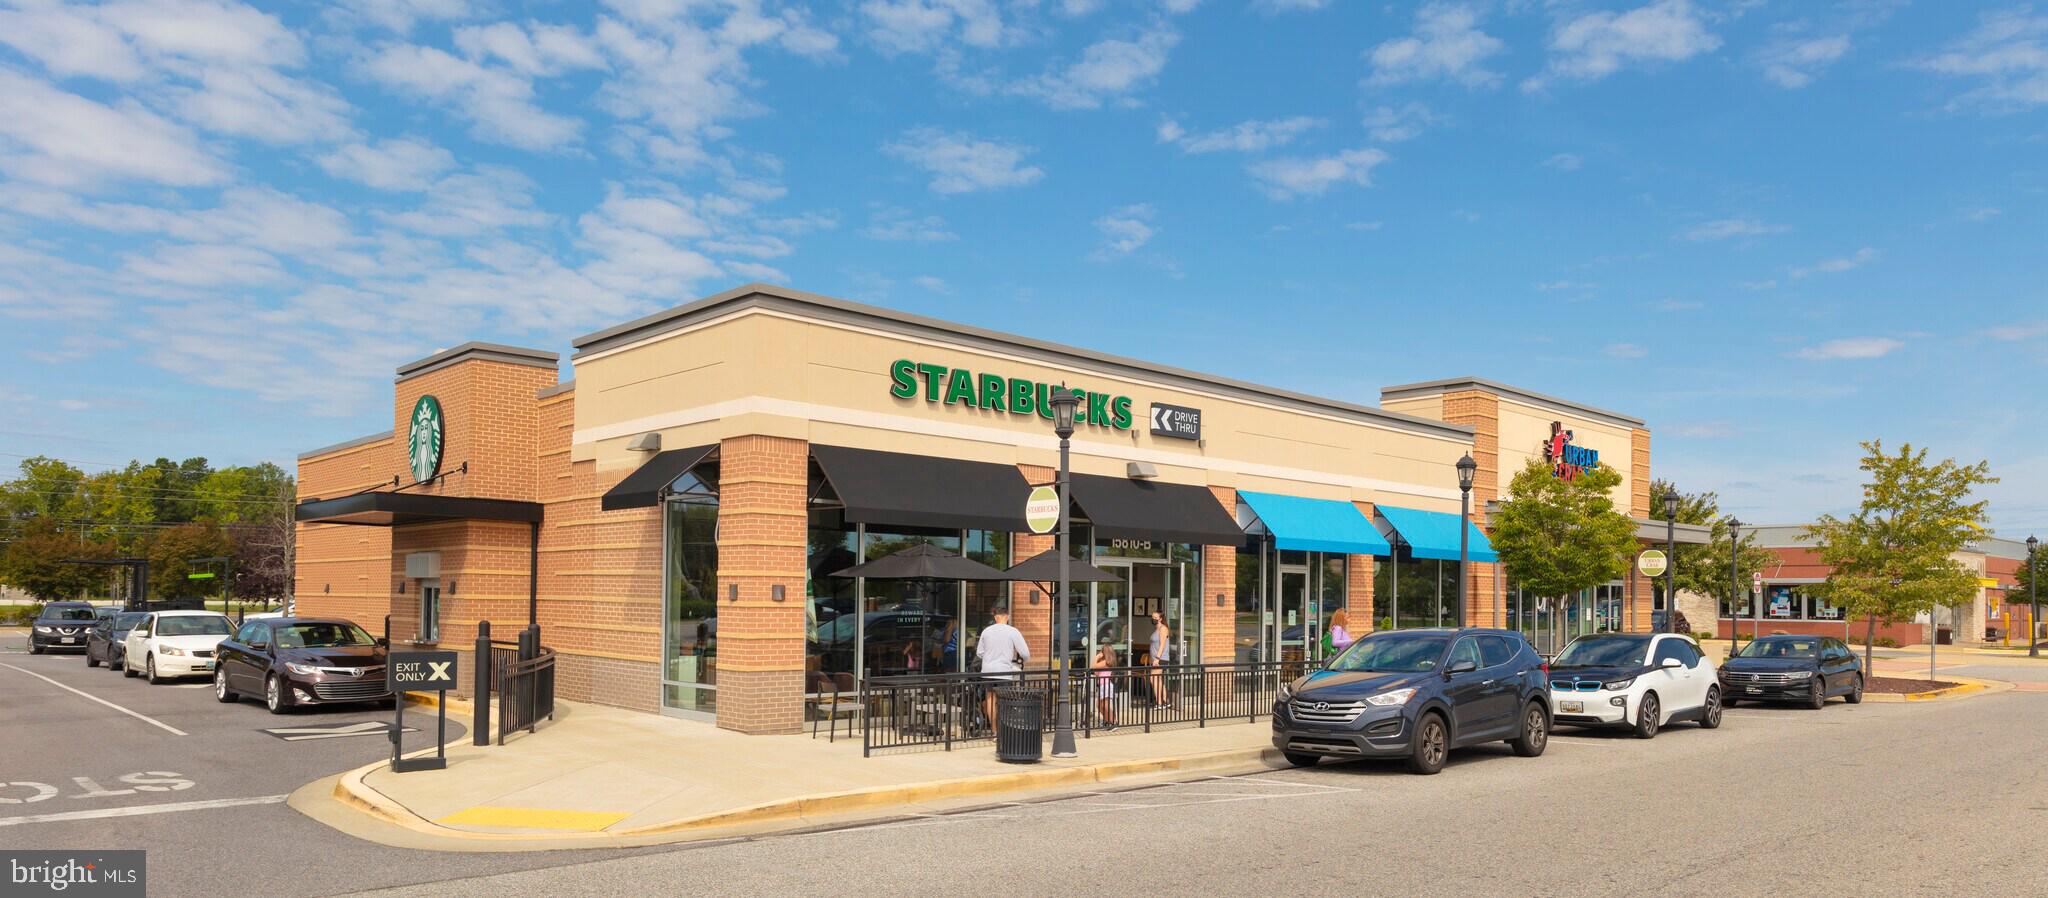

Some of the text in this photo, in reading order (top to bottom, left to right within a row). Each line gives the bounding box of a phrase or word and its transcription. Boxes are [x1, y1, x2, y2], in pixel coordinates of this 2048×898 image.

[1174, 411, 1198, 424] DRIVE
[1174, 421, 1197, 434] THRU
[1563, 443, 1599, 469] URBAN
[1112, 537, 1151, 550] 15810-B
[396, 663, 420, 672] EXIT
[395, 672, 426, 682] ONLY
